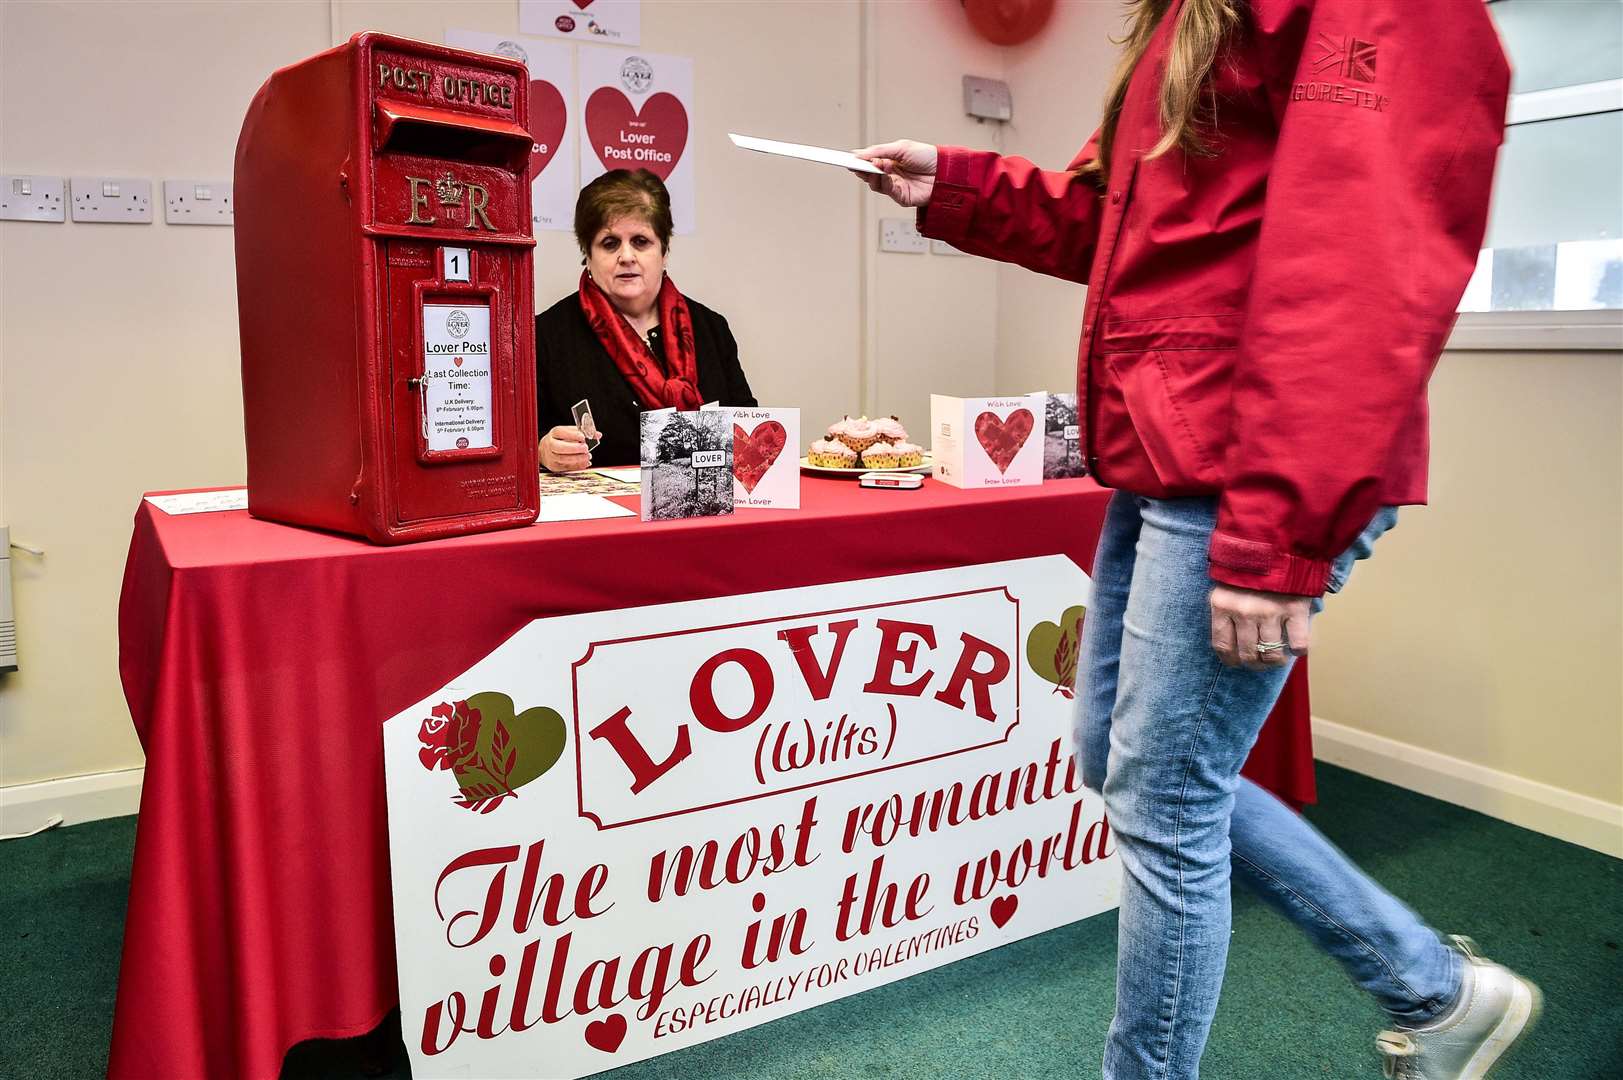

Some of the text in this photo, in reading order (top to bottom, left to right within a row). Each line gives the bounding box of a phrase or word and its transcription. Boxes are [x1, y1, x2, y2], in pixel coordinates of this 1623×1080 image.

[378, 63, 513, 109] POST OFFICE
[620, 130, 655, 144] Lover
[604, 146, 671, 163] Post Office
[404, 175, 436, 225] E
[464, 183, 499, 231] R
[450, 255, 459, 275] 1
[426, 341, 488, 353] Lover Post
[428, 369, 489, 378] Last Collection
[448, 382, 471, 390] Time:
[752, 411, 770, 419] Love
[695, 455, 722, 463] LOVER
[588, 618, 1011, 796] LOVER
[753, 703, 898, 785] (Wilts)
[434, 737, 1085, 949] The most romanti
[420, 799, 1118, 1057] village in the world
[653, 916, 979, 1039] ESPECIALLY FOR VALENTINES
